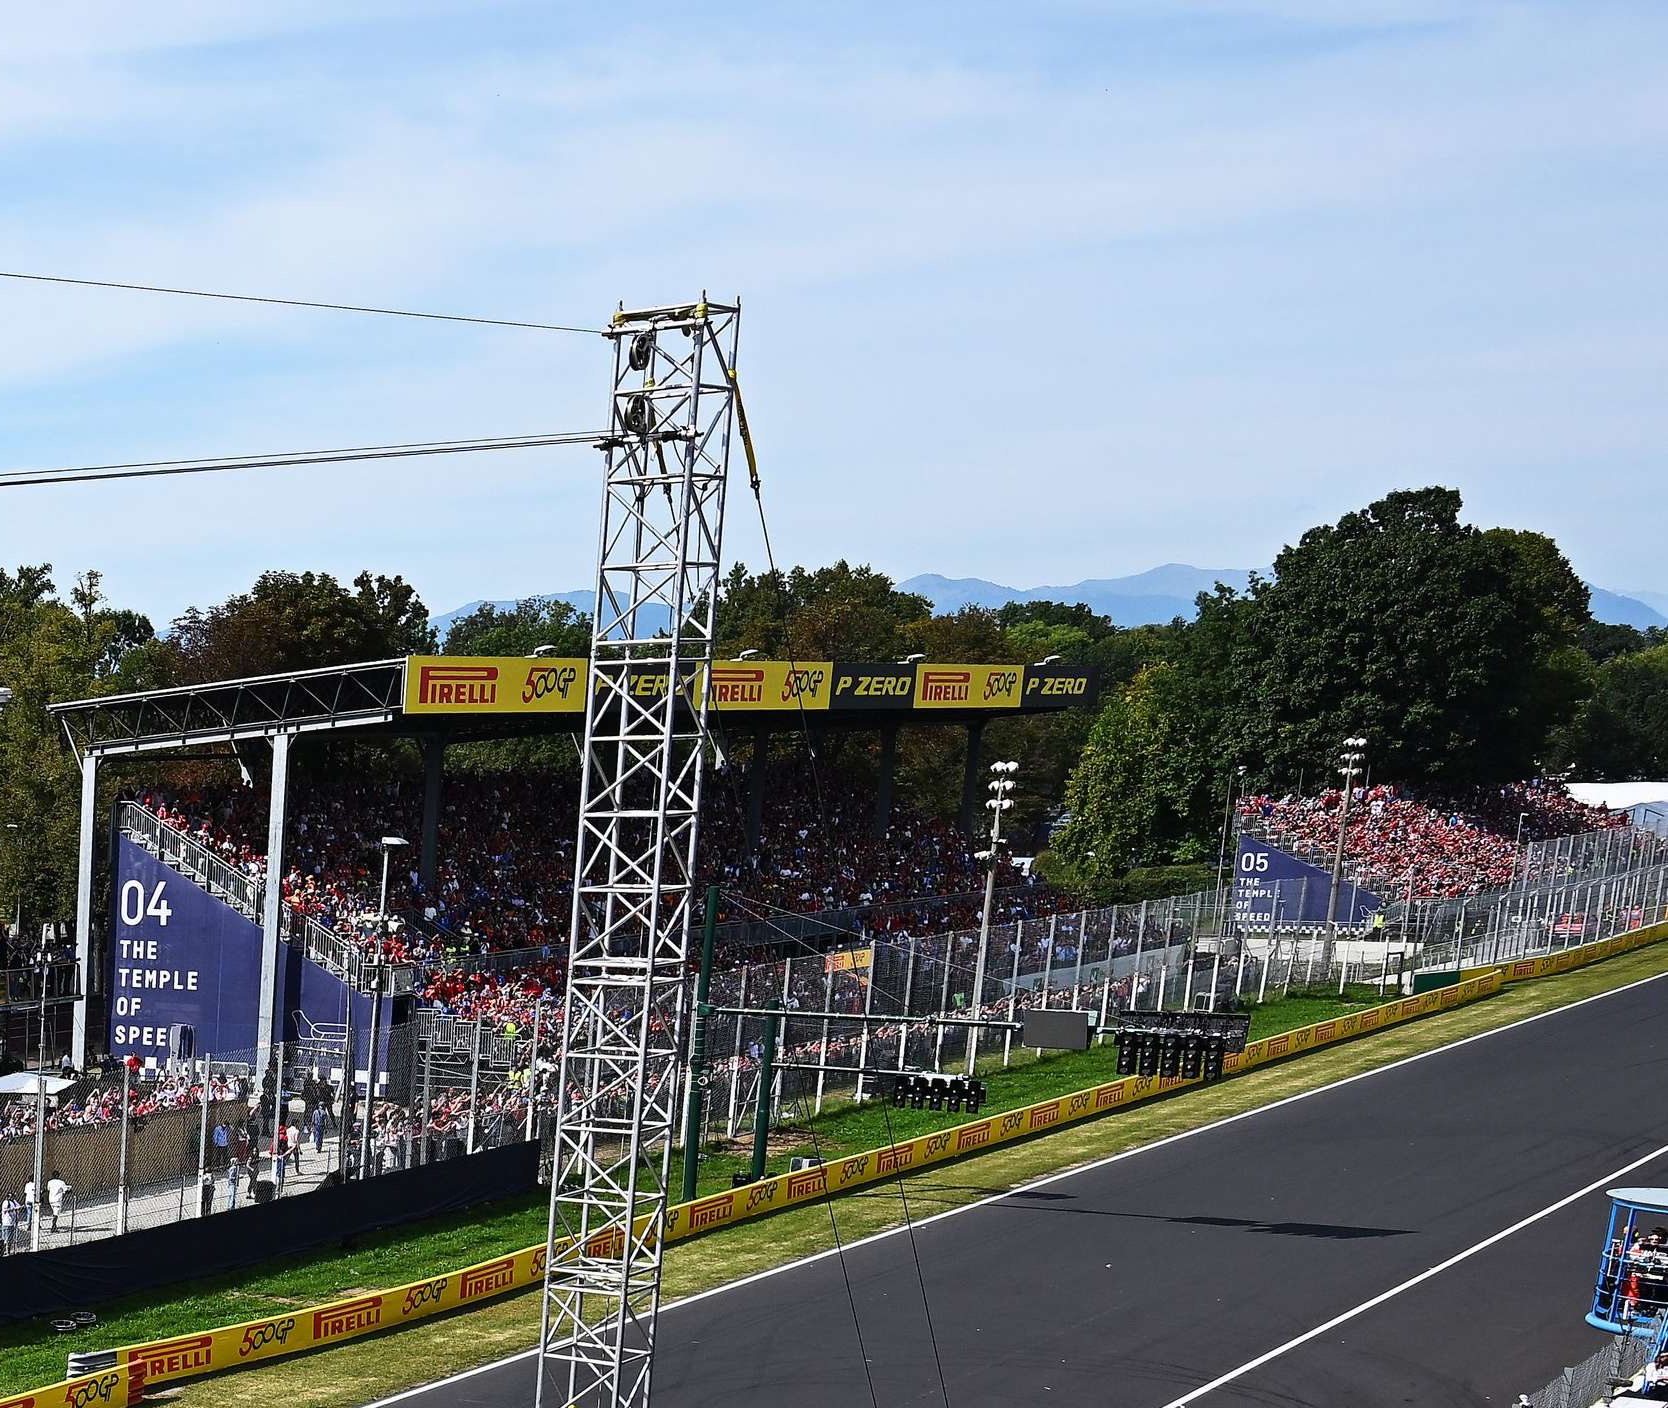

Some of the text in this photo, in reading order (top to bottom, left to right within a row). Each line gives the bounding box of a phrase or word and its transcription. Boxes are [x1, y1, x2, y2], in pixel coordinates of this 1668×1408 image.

[419, 666, 499, 704] PIRELLI
[835, 676, 912, 696] P ZERO
[922, 671, 971, 701] PIRELLI
[1026, 677, 1088, 695] P ZERO
[1241, 852, 1269, 872] 05
[1239, 877, 1261, 886] THE
[120, 879, 172, 926] 04
[119, 939, 158, 960] THE
[118, 968, 199, 991] TEMPLE
[116, 996, 142, 1017] OF
[114, 1025, 169, 1047] SPEE
[1315, 1022, 1336, 1042] PIRELLI
[1266, 1035, 1289, 1058] PIRELLI
[1095, 1083, 1125, 1108] PIRELLI
[1029, 1102, 1060, 1129] PIRELLI
[957, 1122, 992, 1150] PIRELLI
[876, 1144, 914, 1174] PIRELLI
[787, 1167, 828, 1199] PIRELLI
[689, 1195, 734, 1229] PIRELLI
[460, 1259, 515, 1299] PIRELLI
[312, 1296, 382, 1340] PIRELLI
